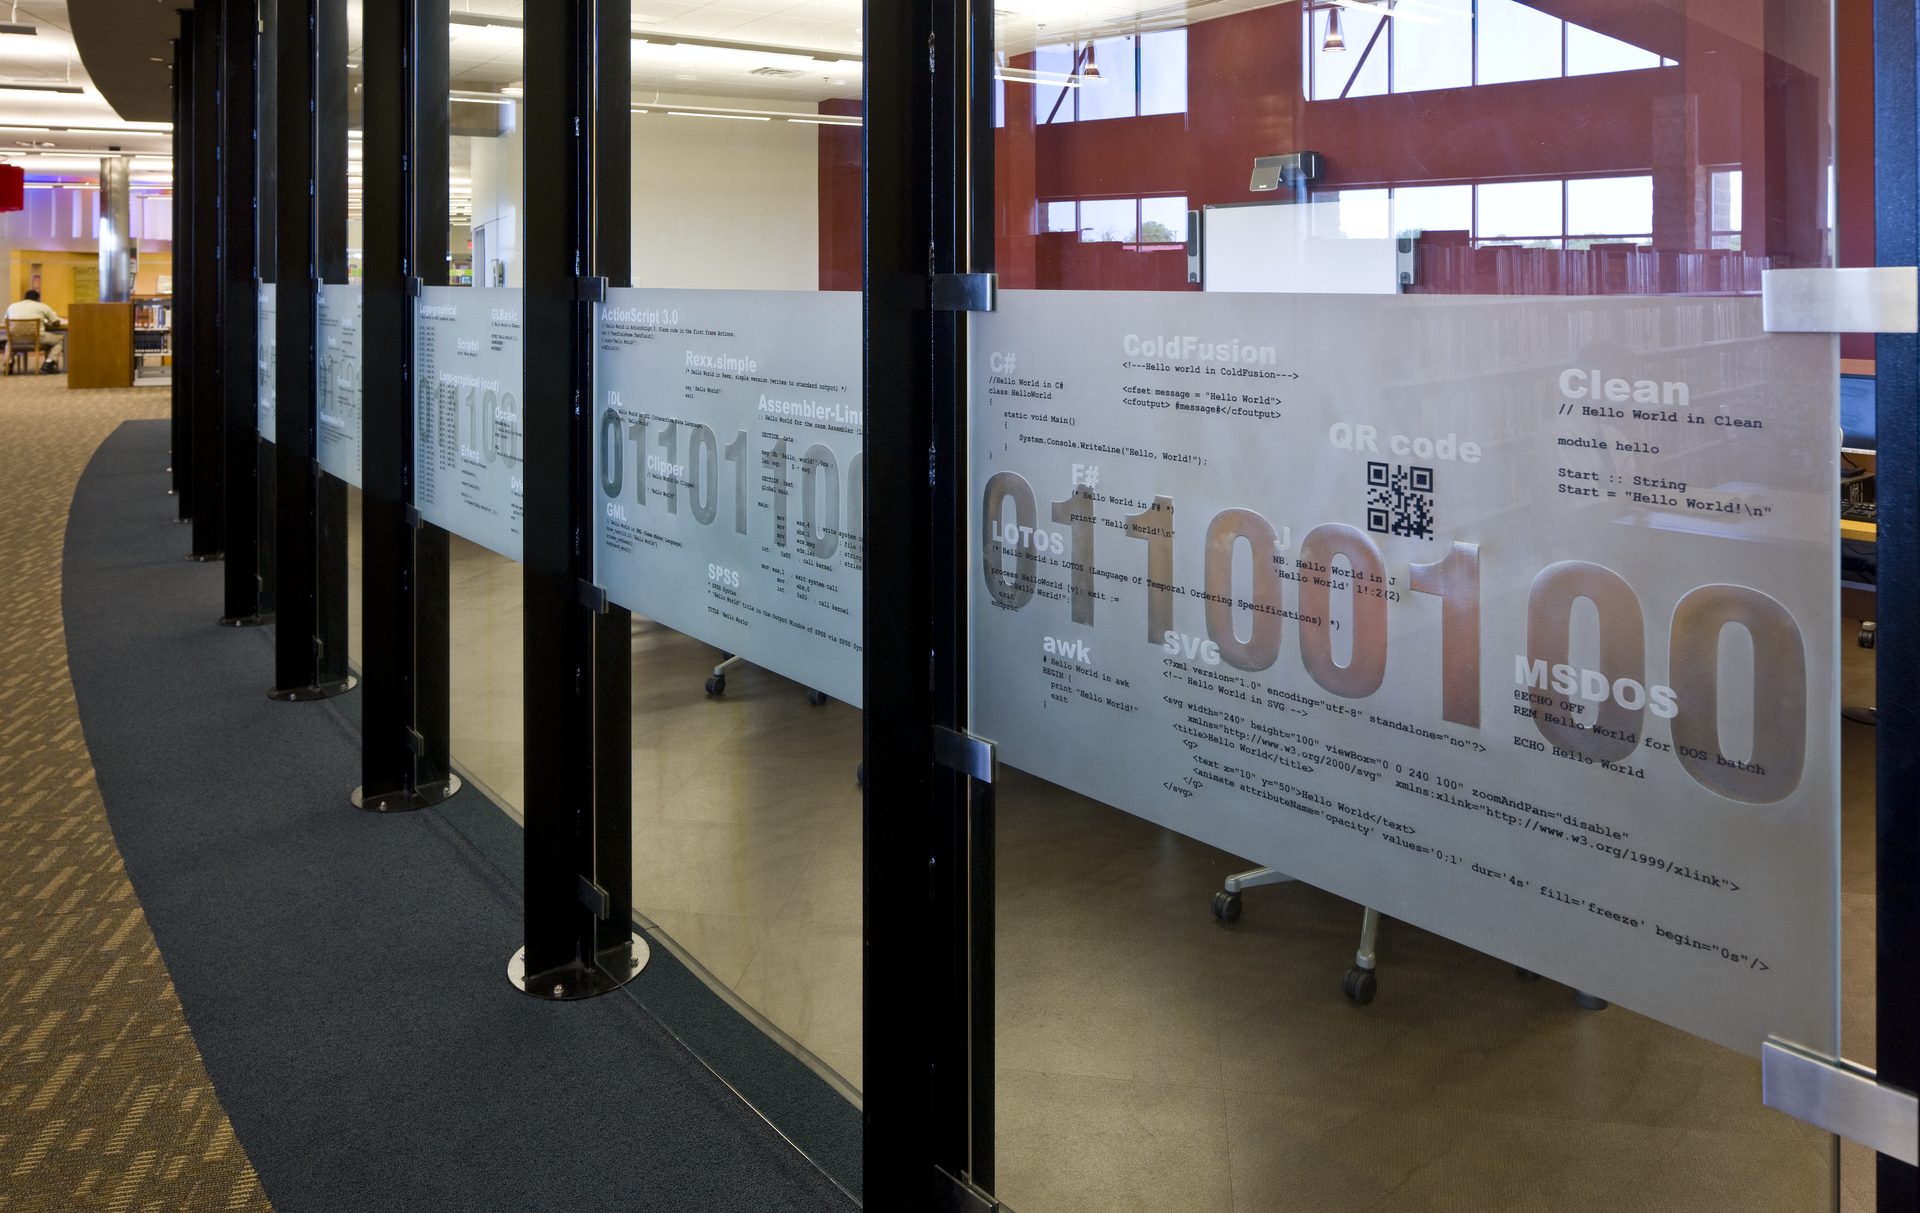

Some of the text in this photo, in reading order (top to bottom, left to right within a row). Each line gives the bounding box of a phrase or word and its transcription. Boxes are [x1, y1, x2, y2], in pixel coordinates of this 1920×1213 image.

[602, 306, 678, 326] ActionScript 3.0
[1123, 333, 1277, 365] ColdFusion
[686, 350, 757, 374] Rexx.simple
[989, 351, 1017, 374] C#
[1175, 365, 1200, 374] world
[1206, 367, 1216, 375] in
[989, 376, 1064, 390] //Hello World in C#
[989, 387, 1052, 400] class HelloWorld
[1559, 368, 1690, 406] Clean
[608, 390, 622, 407] IDL
[1122, 385, 1282, 406] <cfset message "Hello World">
[1122, 398, 1170, 410] <cfoutput>
[1004, 410, 1076, 426] static void Main()
[1582, 406, 1762, 429] Hello World in Clean
[1329, 422, 1482, 464] QR code
[1558, 436, 1660, 454] module hello
[647, 454, 684, 478] Clipper
[1072, 463, 1099, 488] F#
[1558, 468, 1687, 493] Start String
[1084, 492, 1106, 502] Hello
[1110, 496, 1133, 507] World
[1137, 500, 1147, 510] in
[1558, 484, 1600, 498] Start
[1625, 491, 1678, 507] "Hello
[606, 502, 626, 522] GML
[1070, 513, 1096, 524] printf
[1101, 518, 1128, 530] "Hello
[992, 520, 1064, 555] LOTOS
[1274, 527, 1290, 550] J
[708, 563, 740, 588] SPSS
[1272, 554, 1382, 584] NB. Hello World in
[1274, 568, 1308, 584] 'Hello
[1313, 575, 1350, 591] World'
[991, 567, 1106, 600] process HelloWorld exit
[1002, 547, 1322, 628] Hello World in LOTOS (Language Of Temporal Ordering Specifications)
[991, 600, 1018, 612] endproc
[1043, 635, 1092, 664] awk
[1164, 630, 1221, 666] SVG
[1042, 666, 1064, 680] BEGIN
[1050, 657, 1130, 688] Hello World in awk
[1162, 658, 1188, 672] <?xml
[1050, 681, 1072, 695] print
[1076, 688, 1103, 704] "Hello
[1050, 692, 1069, 704] exit
[1188, 676, 1285, 712] Hello World in SVG
[1514, 654, 1679, 719] MSDOS
[1514, 690, 1585, 714] @ECHO OFF
[1162, 694, 1184, 710] <svg
[1188, 701, 1246, 726] width="240"
[1396, 764, 1402, 773] 0
[1409, 767, 1430, 782] 240
[1436, 776, 1464, 790] 100"
[1182, 738, 1198, 750] <g>
[1514, 706, 1766, 776] REM Hello World for DOS batch
[1192, 754, 1220, 769] <text
[1514, 736, 1645, 780] ECHO Hello World
[1183, 776, 1204, 788] </g>
[1193, 766, 1234, 788] <animate
[1162, 782, 1194, 798] </svg>
